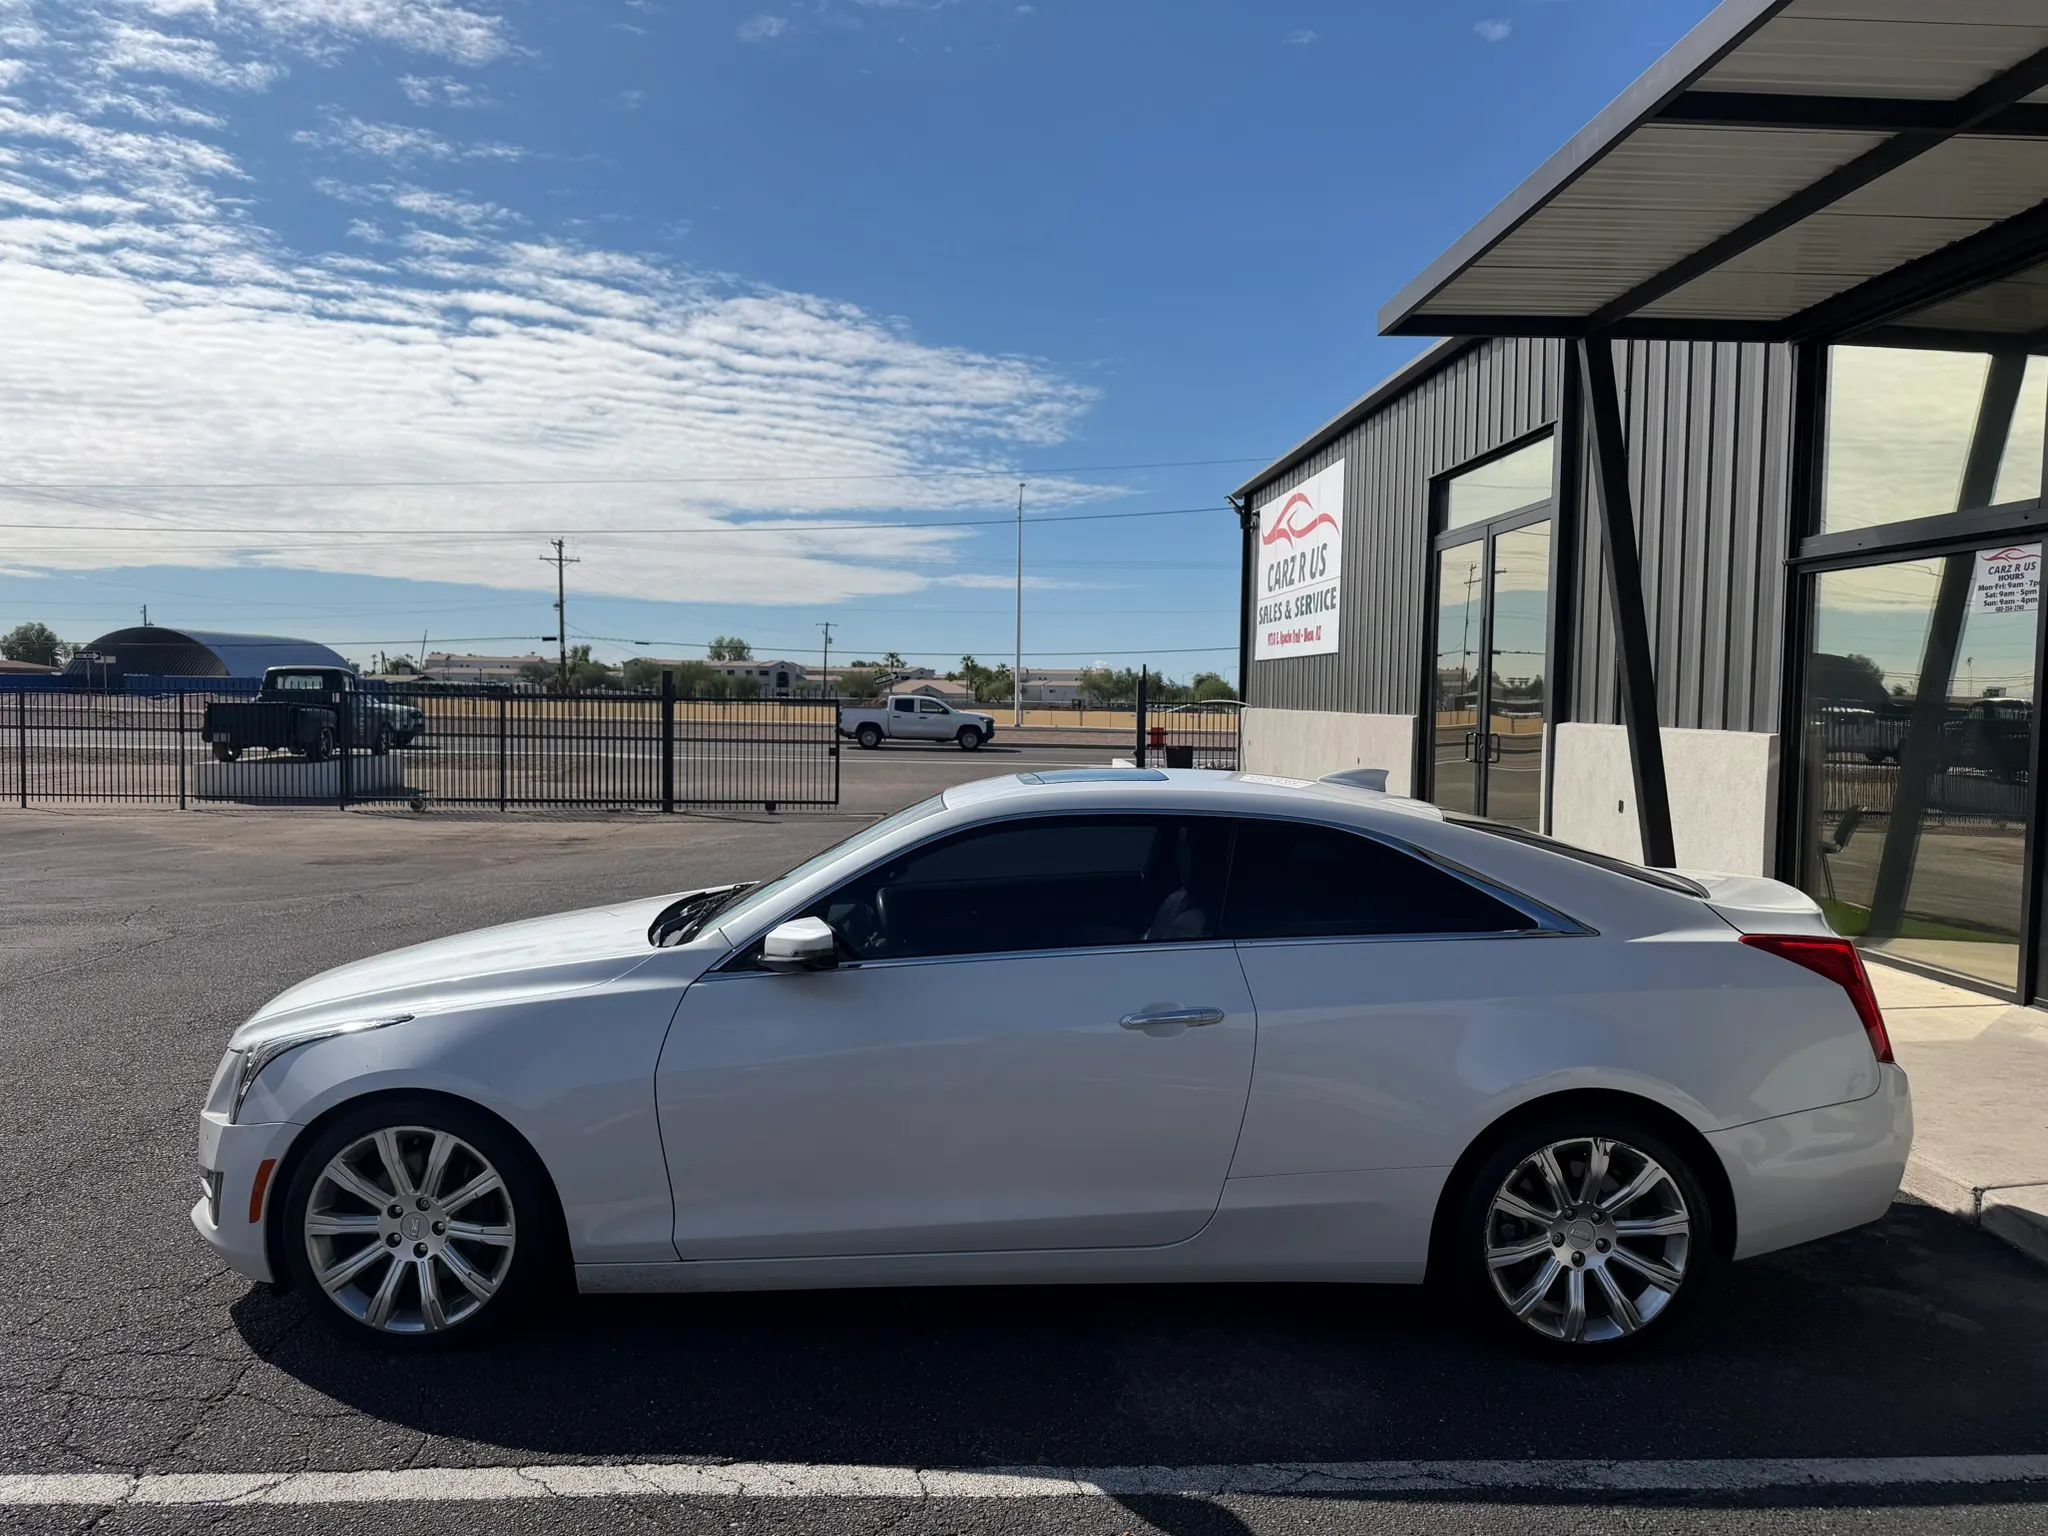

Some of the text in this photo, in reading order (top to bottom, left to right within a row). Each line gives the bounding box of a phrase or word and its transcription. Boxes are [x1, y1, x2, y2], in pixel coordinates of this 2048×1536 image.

[1268, 542, 1328, 592] CARZ R US
[1988, 562, 2036, 574] CARZ R US
[1998, 572, 2024, 582] HOURS
[1978, 582, 2006, 592] Mon-Fri:
[2028, 580, 2040, 588] 7p
[2020, 588, 2038, 596] 5pm
[1259, 586, 1336, 625] SALES & SERVICE
